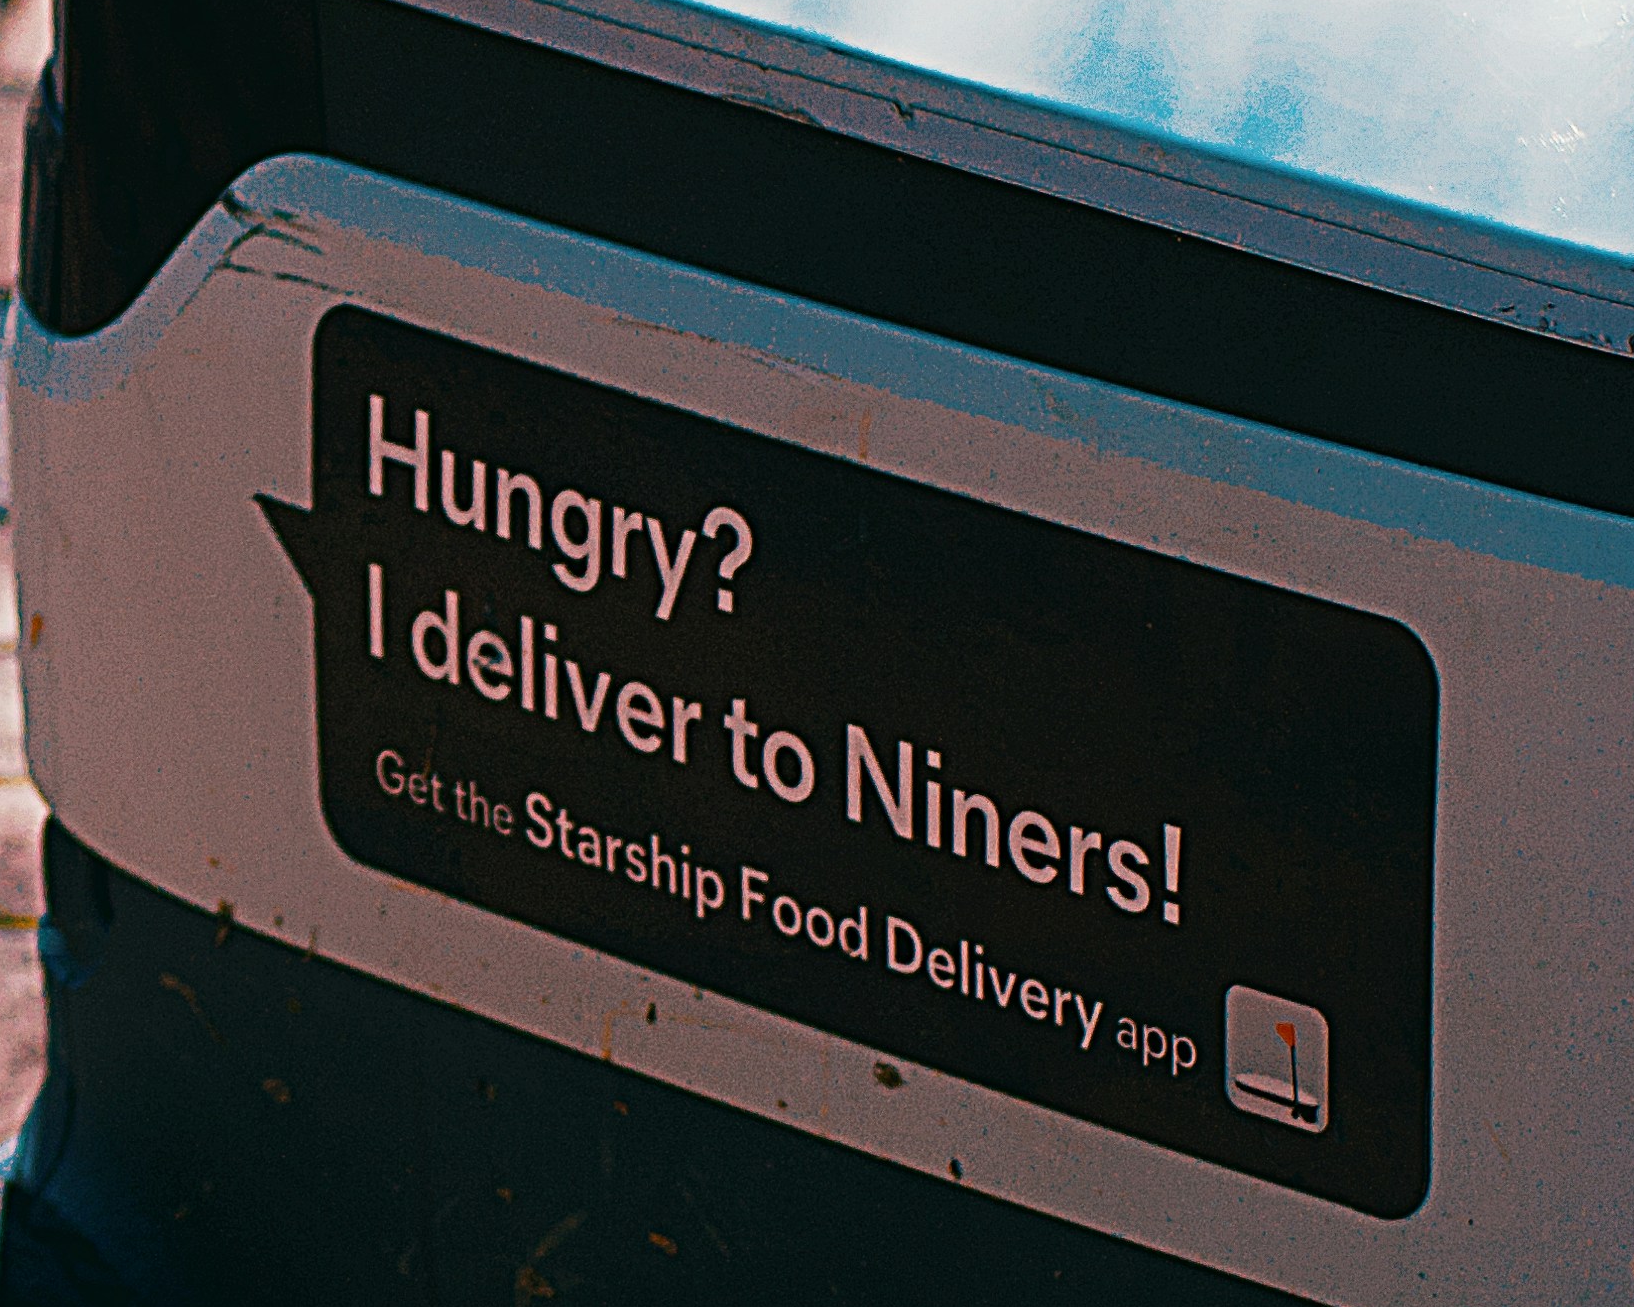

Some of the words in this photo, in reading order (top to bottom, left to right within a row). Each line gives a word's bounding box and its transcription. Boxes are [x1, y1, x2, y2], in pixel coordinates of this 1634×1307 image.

[368, 393, 754, 621] Hungry?
[368, 562, 385, 659] I
[410, 589, 703, 765] deliver
[722, 696, 816, 804] to
[846, 722, 1183, 926] Niners!
[375, 748, 445, 812] Get
[453, 777, 516, 837] the
[524, 791, 726, 920] Starship
[740, 865, 870, 961] Food
[887, 913, 1105, 1051] Delivery
[1114, 1015, 1199, 1077] app
